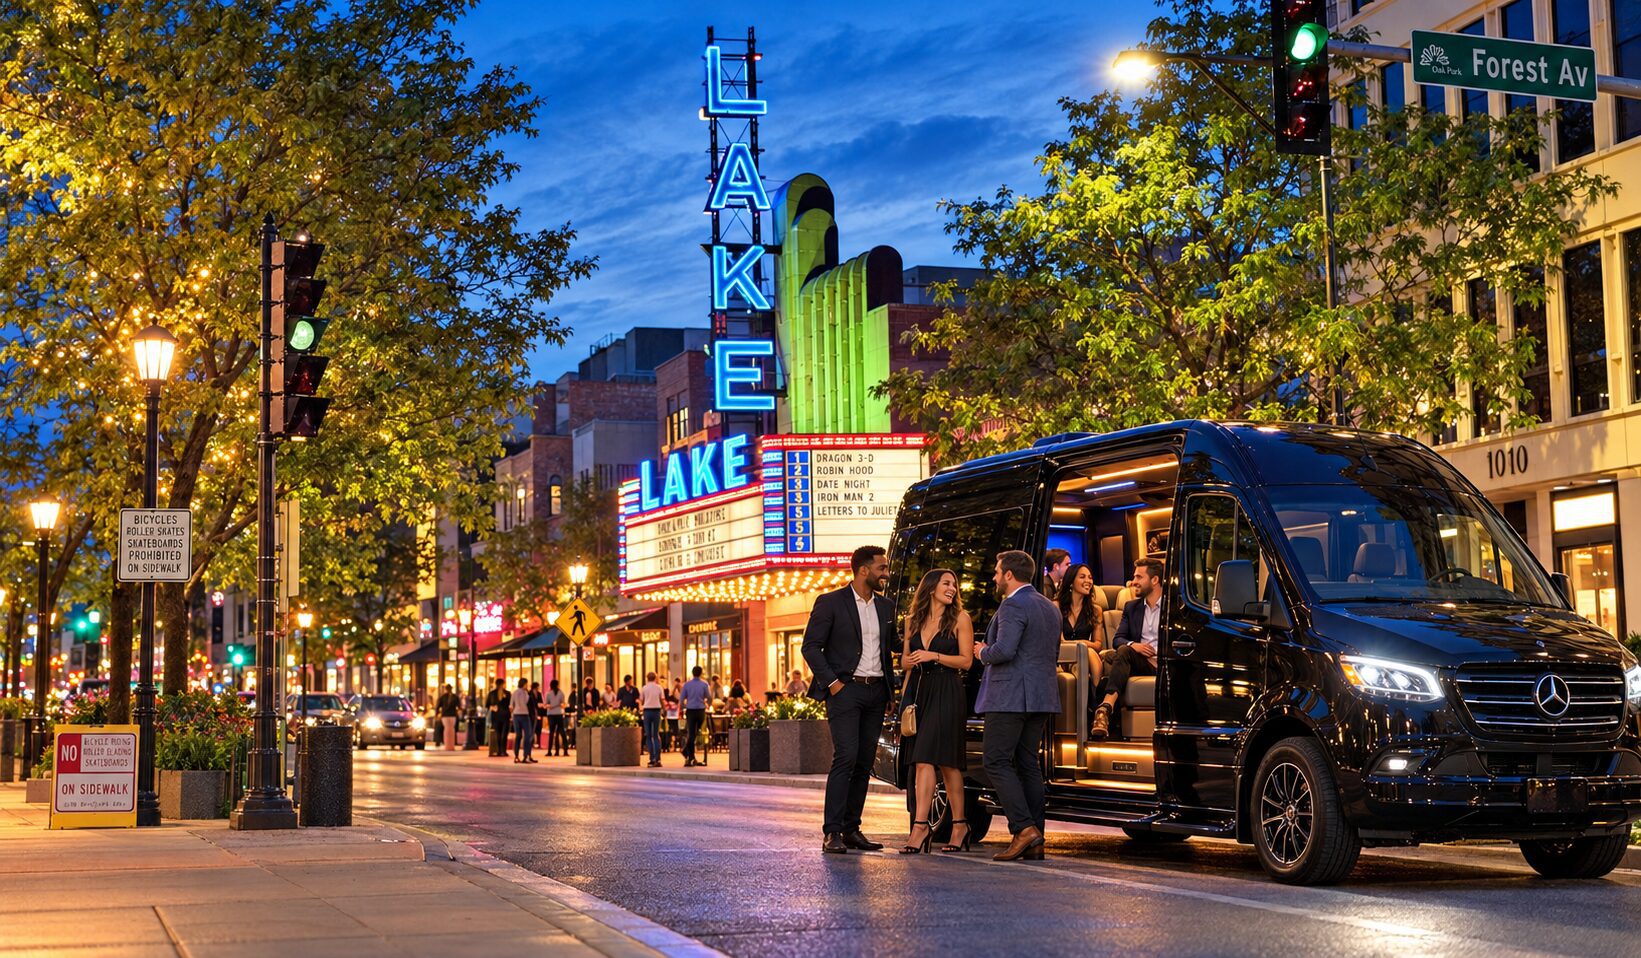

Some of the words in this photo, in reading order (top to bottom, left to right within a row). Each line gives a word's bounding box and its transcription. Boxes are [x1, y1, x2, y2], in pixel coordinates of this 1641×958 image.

[1432, 65, 1446, 74] Oak
[1447, 66, 1463, 76] Park
[1472, 48, 1549, 84] Forest
[1558, 58, 1588, 88] Av
[706, 45, 776, 411] LAKE
[816, 454, 852, 463] DRAGON
[858, 454, 874, 462] 3-D
[1486, 444, 1529, 479] 1010
[641, 434, 747, 511] LAKE
[816, 466, 844, 475] ROBIN
[849, 466, 874, 475] HOOD
[817, 480, 839, 489] DATE
[844, 480, 870, 489] NIGHT
[817, 493, 839, 501] IRON
[844, 493, 863, 501] MAN
[869, 493, 874, 501] 2
[817, 506, 853, 516] LETTERS
[857, 506, 868, 515] TO
[871, 506, 898, 516] JULIET
[134, 515, 178, 525] BICYCLES
[127, 527, 155, 536] ROLLER
[157, 527, 185, 536] SKATES
[128, 539, 183, 548] SKATEBOARDS
[129, 551, 182, 561] PROHIBITED
[128, 563, 139, 573] ON
[143, 563, 182, 573] SIDEWALK
[61, 744, 78, 762] NO
[62, 783, 75, 795] ON
[80, 783, 129, 795] SIDEWALK
